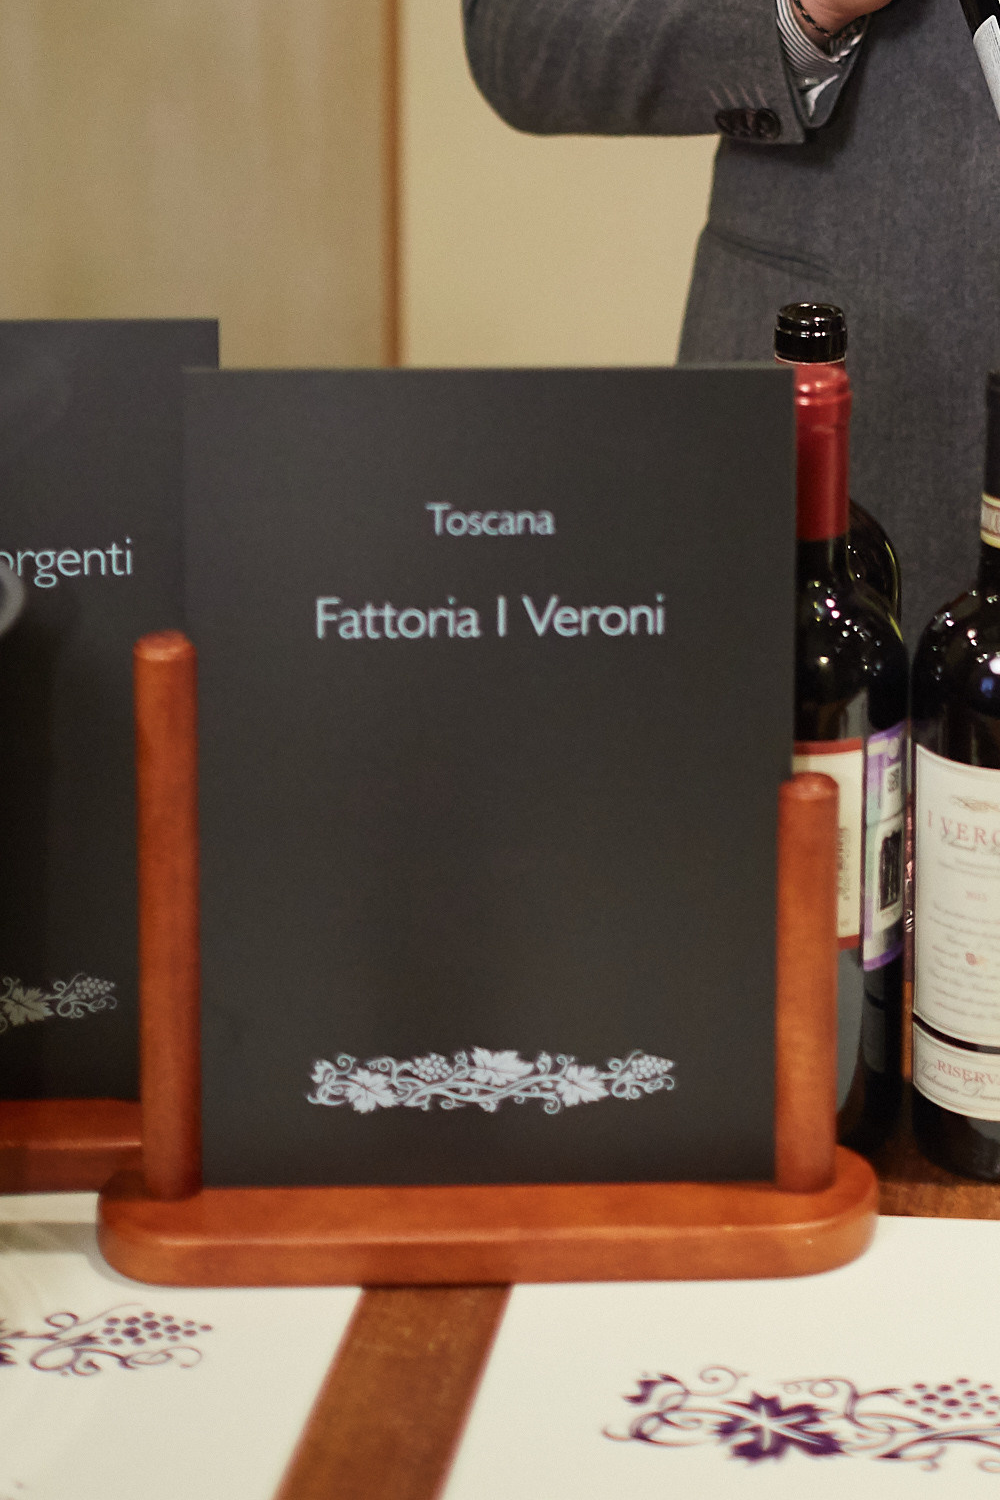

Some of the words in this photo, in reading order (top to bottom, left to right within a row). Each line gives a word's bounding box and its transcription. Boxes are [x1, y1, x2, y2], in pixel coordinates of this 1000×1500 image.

[425, 501, 556, 536] Toscana
[315, 595, 481, 639] Fattoria
[522, 592, 666, 637] Veroni
[927, 809, 933, 828] I
